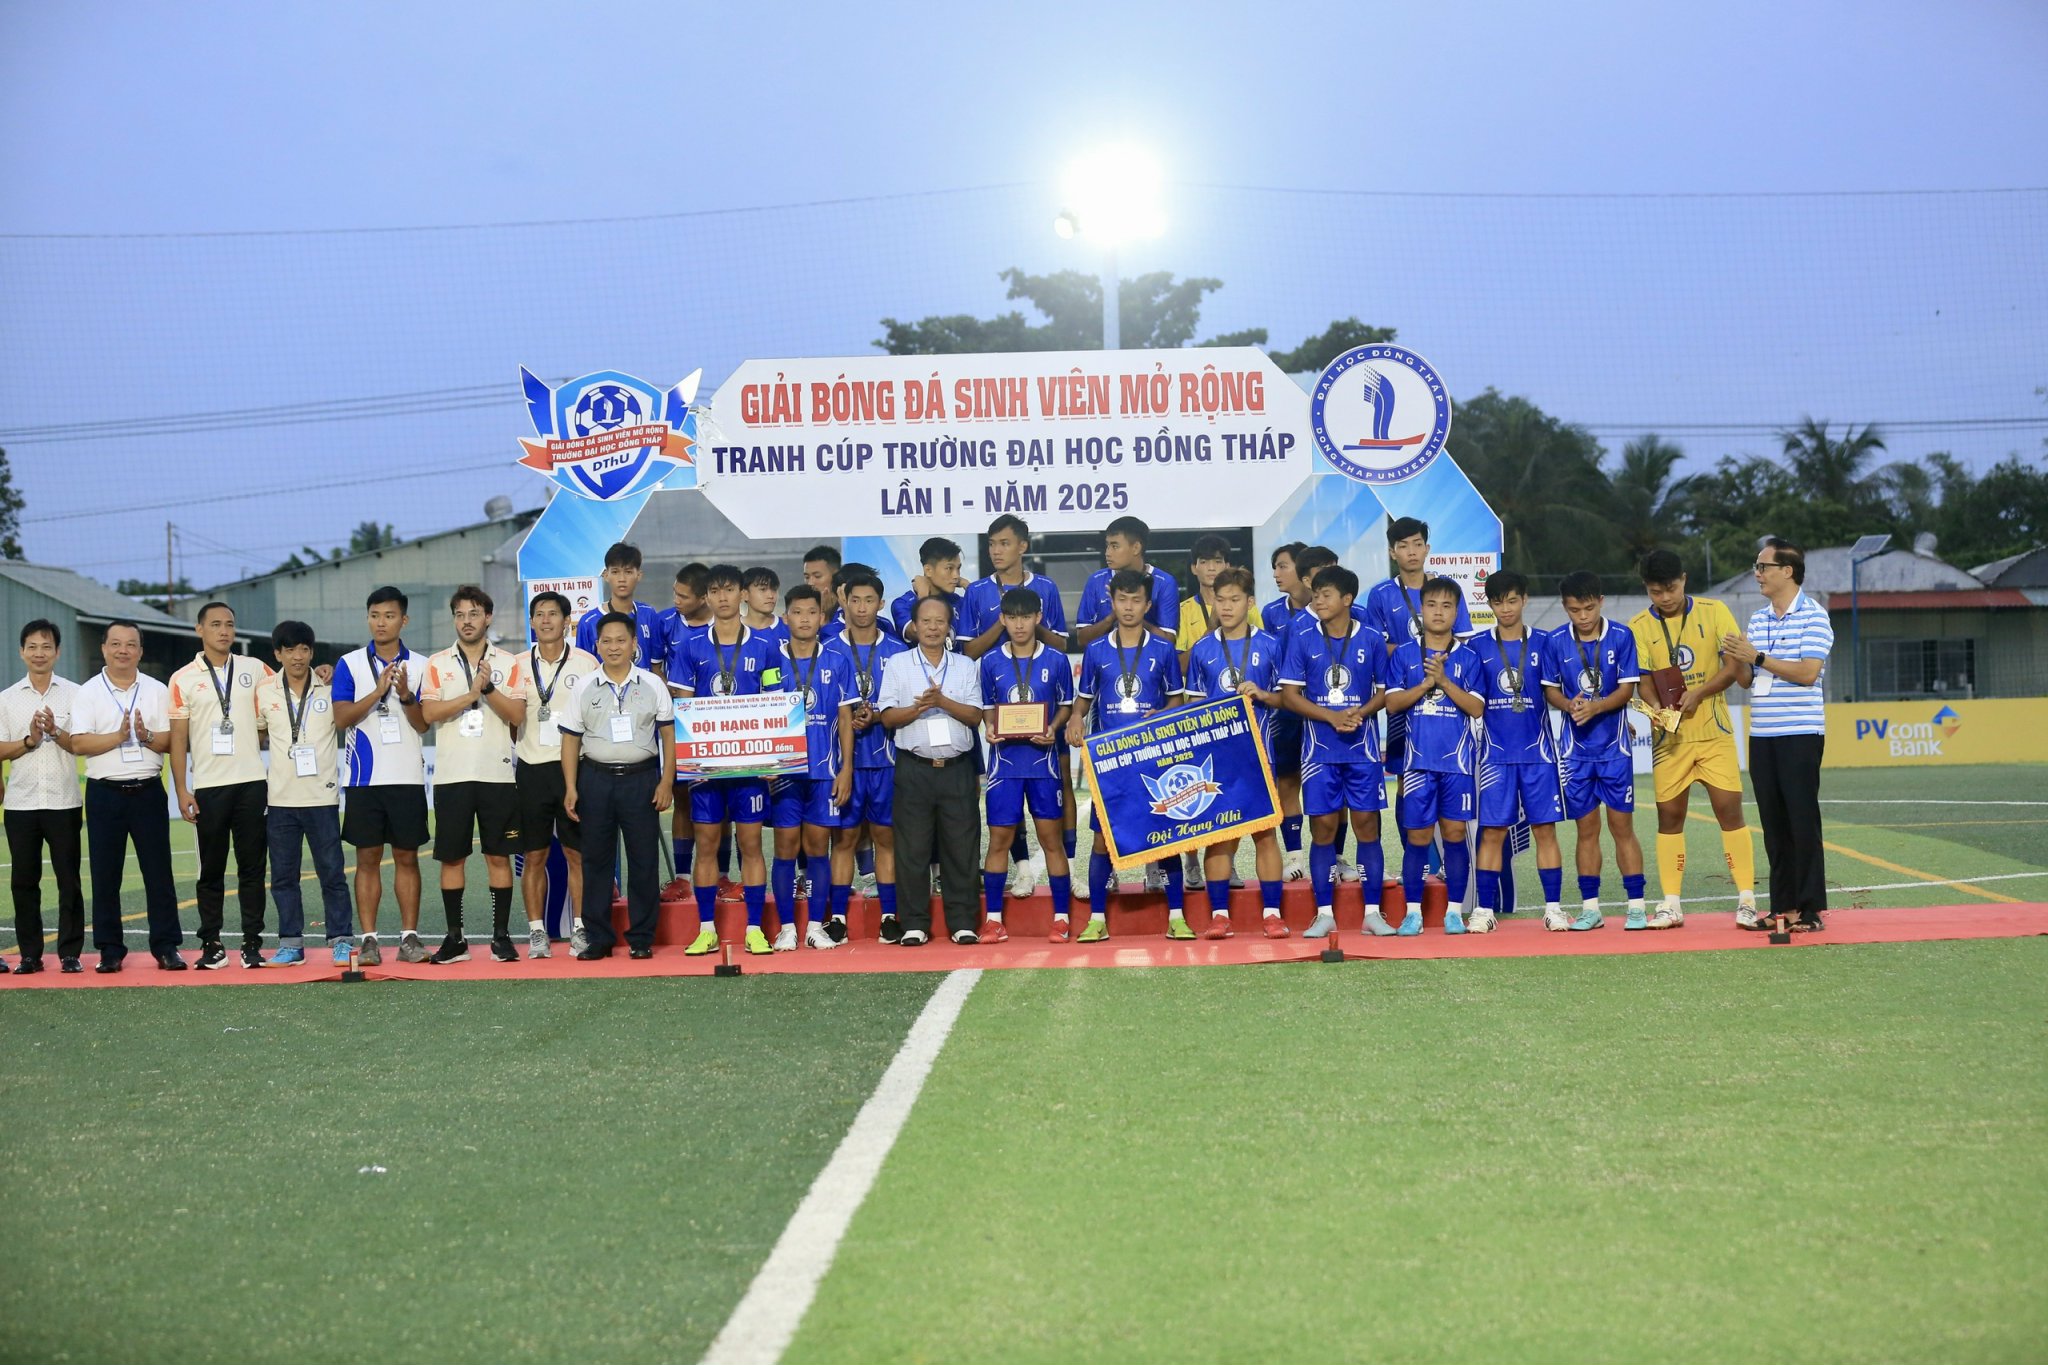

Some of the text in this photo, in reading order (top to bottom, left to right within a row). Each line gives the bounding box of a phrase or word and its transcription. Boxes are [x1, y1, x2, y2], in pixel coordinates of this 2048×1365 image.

[740, 362, 1264, 424] GIẢI BÓNG ĐÁ SINH VIÊN MỞ RỘNG
[551, 426, 664, 450] GIẢI BÓNG ĐÁ SINH VIÊN MỞ RỘNG
[552, 435, 662, 461] TRƯỜNG ĐẠI HỌC ĐỒNG THÁP
[712, 426, 1295, 474] TRANH CÚP TRƯỜNG ĐẠI HỌC ĐỒNG THÁP
[1316, 427, 1444, 480] DONG THAP UNIVERSITY
[592, 453, 630, 472] DThU
[881, 479, 932, 515] LẦN
[944, 487, 952, 514] I
[985, 479, 1047, 512] NĂM
[1058, 483, 1129, 511] 2025
[641, 625, 650, 638] 19
[1698, 623, 1704, 639] 1
[744, 657, 755, 672] 10
[1149, 658, 1156, 672] 7
[1252, 652, 1259, 667] 6
[1357, 649, 1365, 664] 5
[1531, 652, 1538, 666] 3
[1608, 650, 1615, 665] 2
[821, 669, 831, 684] 12
[1041, 668, 1049, 682] 8
[1454, 663, 1461, 678] 11
[692, 716, 788, 734] ĐỘI HẠNG NHÌ
[1096, 706, 1239, 756] GIẢI BÓNG ĐÁ SINH VIÊN MỞ RỘNG
[1856, 718, 1932, 740] PVcom
[690, 740, 773, 757] 15.000.000
[1889, 740, 1943, 757] Bank
[1056, 789, 1063, 807] 8
[1462, 793, 1471, 811] 11
[1625, 786, 1632, 803] 2
[751, 794, 763, 813] 10
